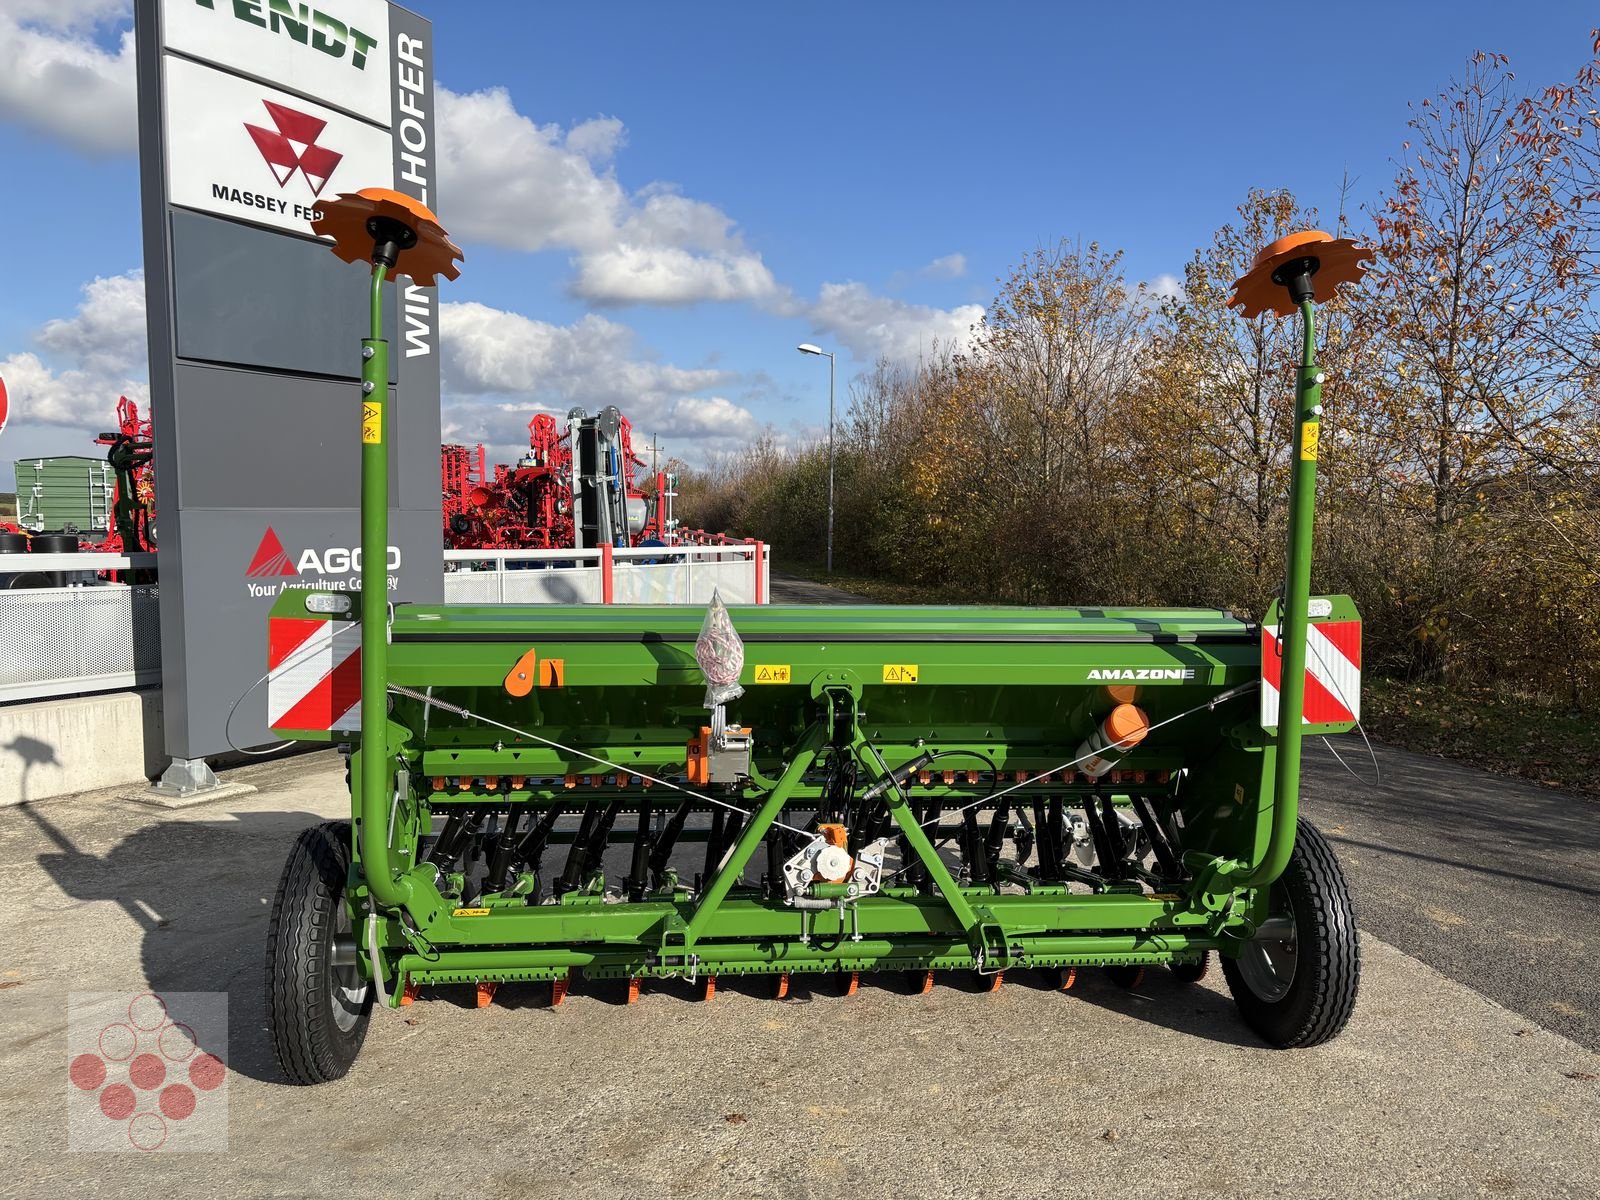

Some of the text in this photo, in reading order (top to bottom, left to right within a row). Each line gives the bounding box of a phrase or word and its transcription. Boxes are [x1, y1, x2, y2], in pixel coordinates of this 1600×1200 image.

[196, 0, 378, 71] ENDT
[212, 183, 287, 214] MASSEY
[248, 583, 277, 597] Your
[1087, 669, 1195, 680] AMAZONE
